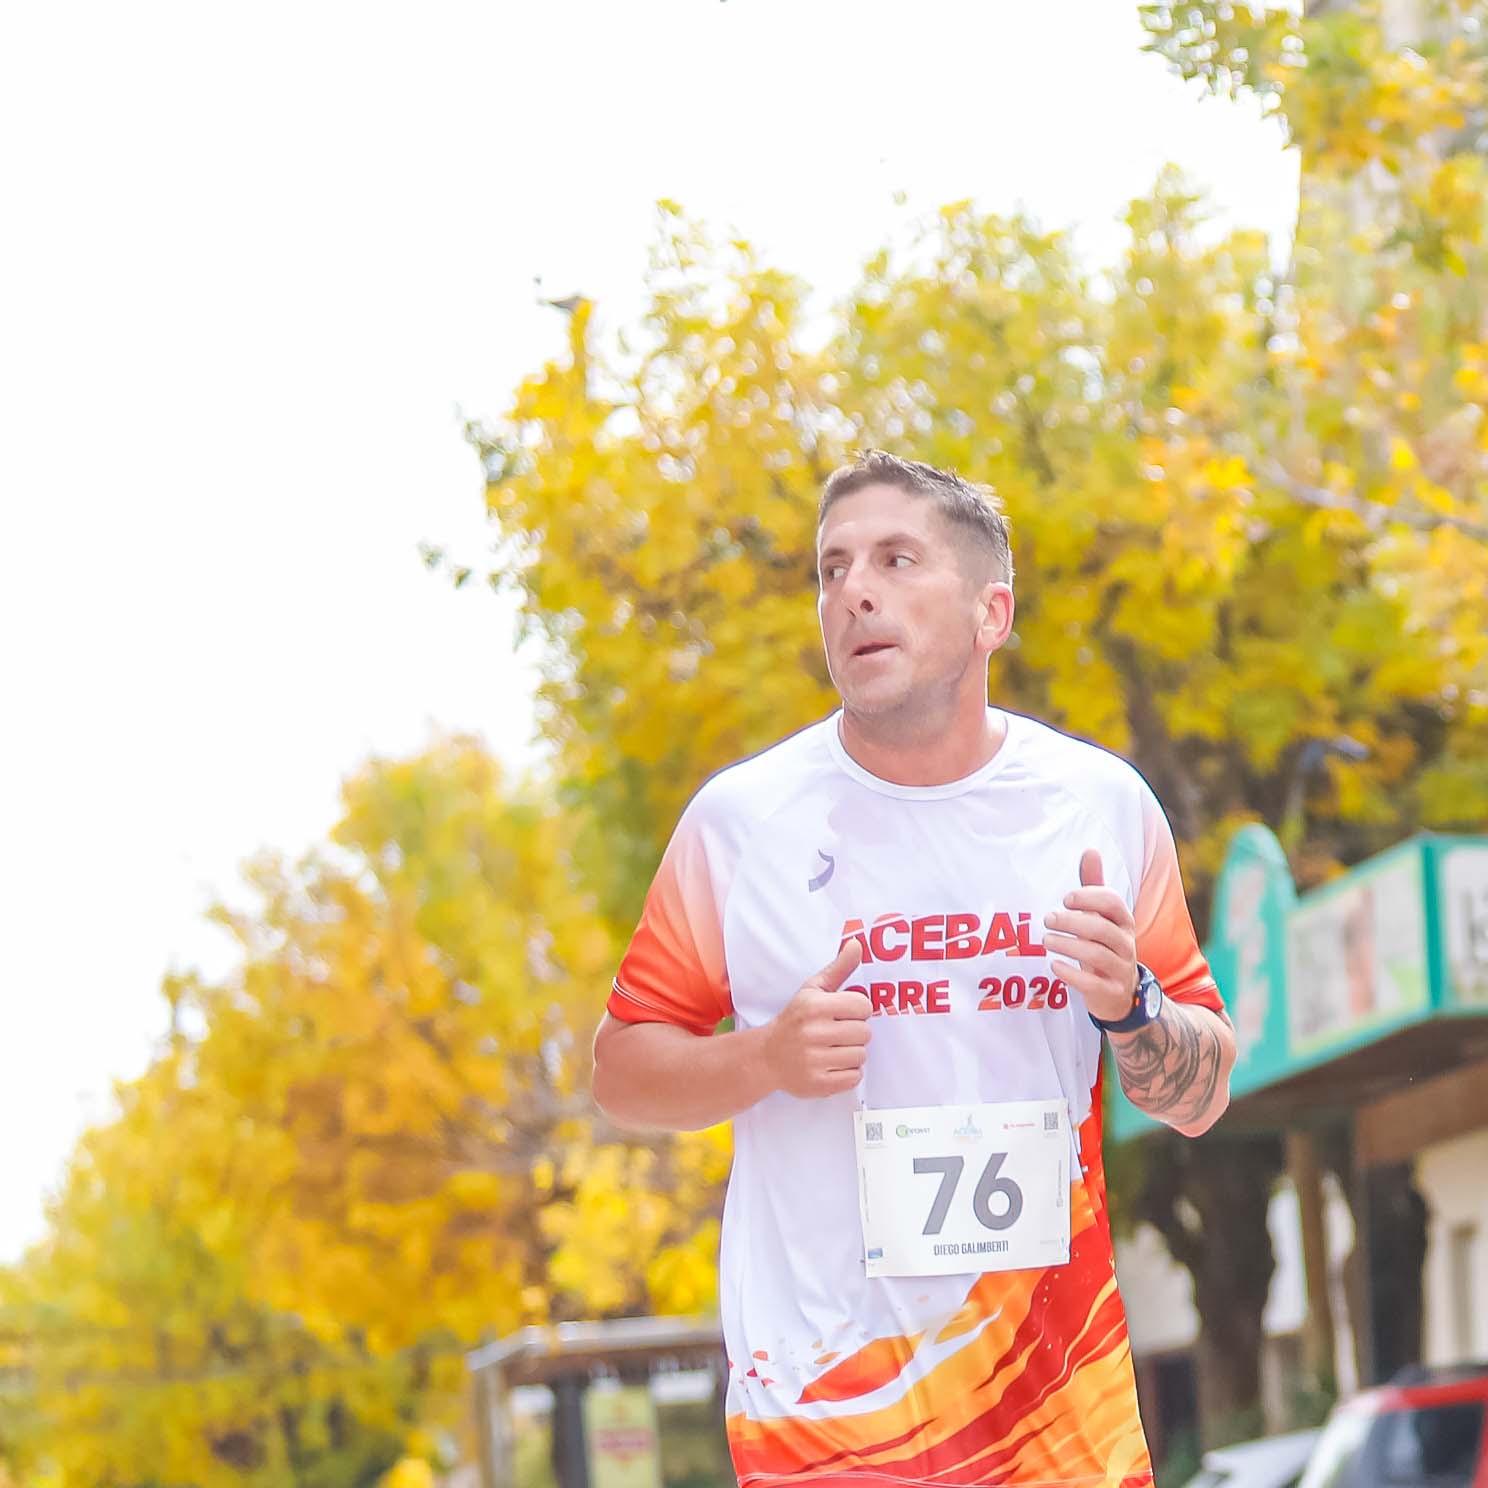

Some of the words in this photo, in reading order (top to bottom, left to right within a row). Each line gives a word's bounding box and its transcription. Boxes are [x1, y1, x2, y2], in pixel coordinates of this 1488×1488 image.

[837, 912, 1047, 964] ACEBAL
[843, 980, 951, 1017] RRE
[977, 975, 1069, 1011] 2026
[913, 1152, 1023, 1235] 76
[934, 1243, 960, 1256] DIEGO
